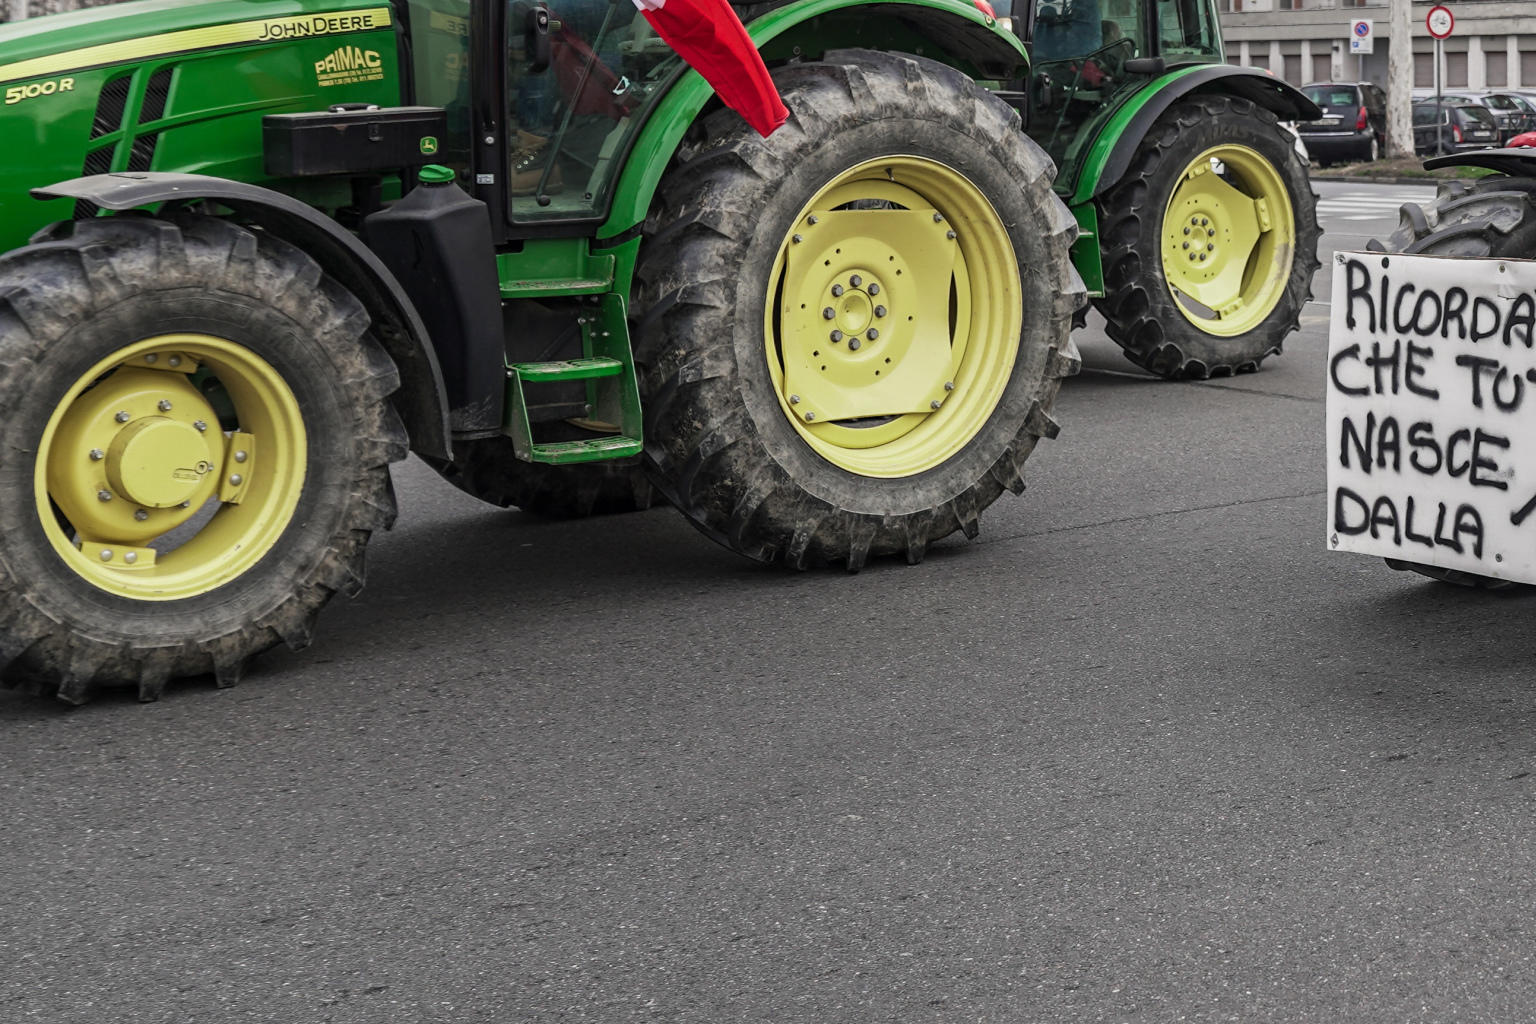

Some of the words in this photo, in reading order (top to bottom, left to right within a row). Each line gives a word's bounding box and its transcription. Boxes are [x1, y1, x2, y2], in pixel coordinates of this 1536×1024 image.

[259, 22, 310, 39] JOHN
[313, 16, 374, 32] DEERE
[315, 46, 381, 74] PRIMAC
[1330, 339, 1440, 400] CHE
[1340, 411, 1511, 491] NASCE
[1334, 486, 1484, 560] DALLA
